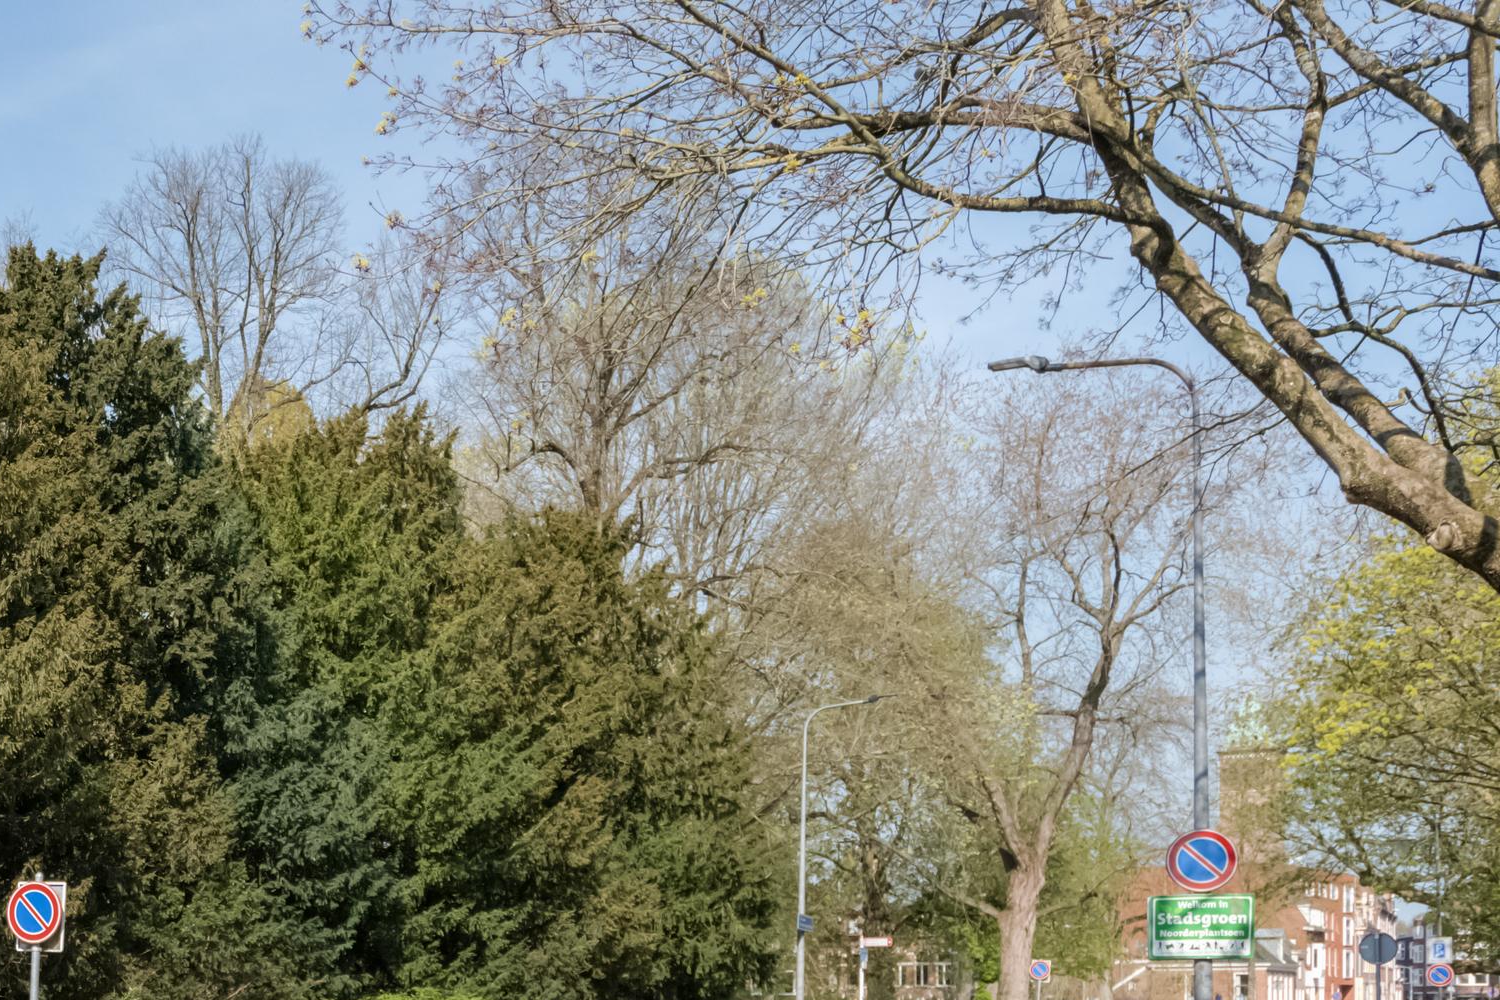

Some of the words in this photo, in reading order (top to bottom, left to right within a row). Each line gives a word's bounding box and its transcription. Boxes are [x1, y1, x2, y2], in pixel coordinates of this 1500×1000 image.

[1177, 900, 1216, 908] Welkom
[1219, 900, 1228, 908] in
[1157, 912, 1247, 928] Stadsgroen
[1160, 929, 1244, 938] Noorderplantsoen
